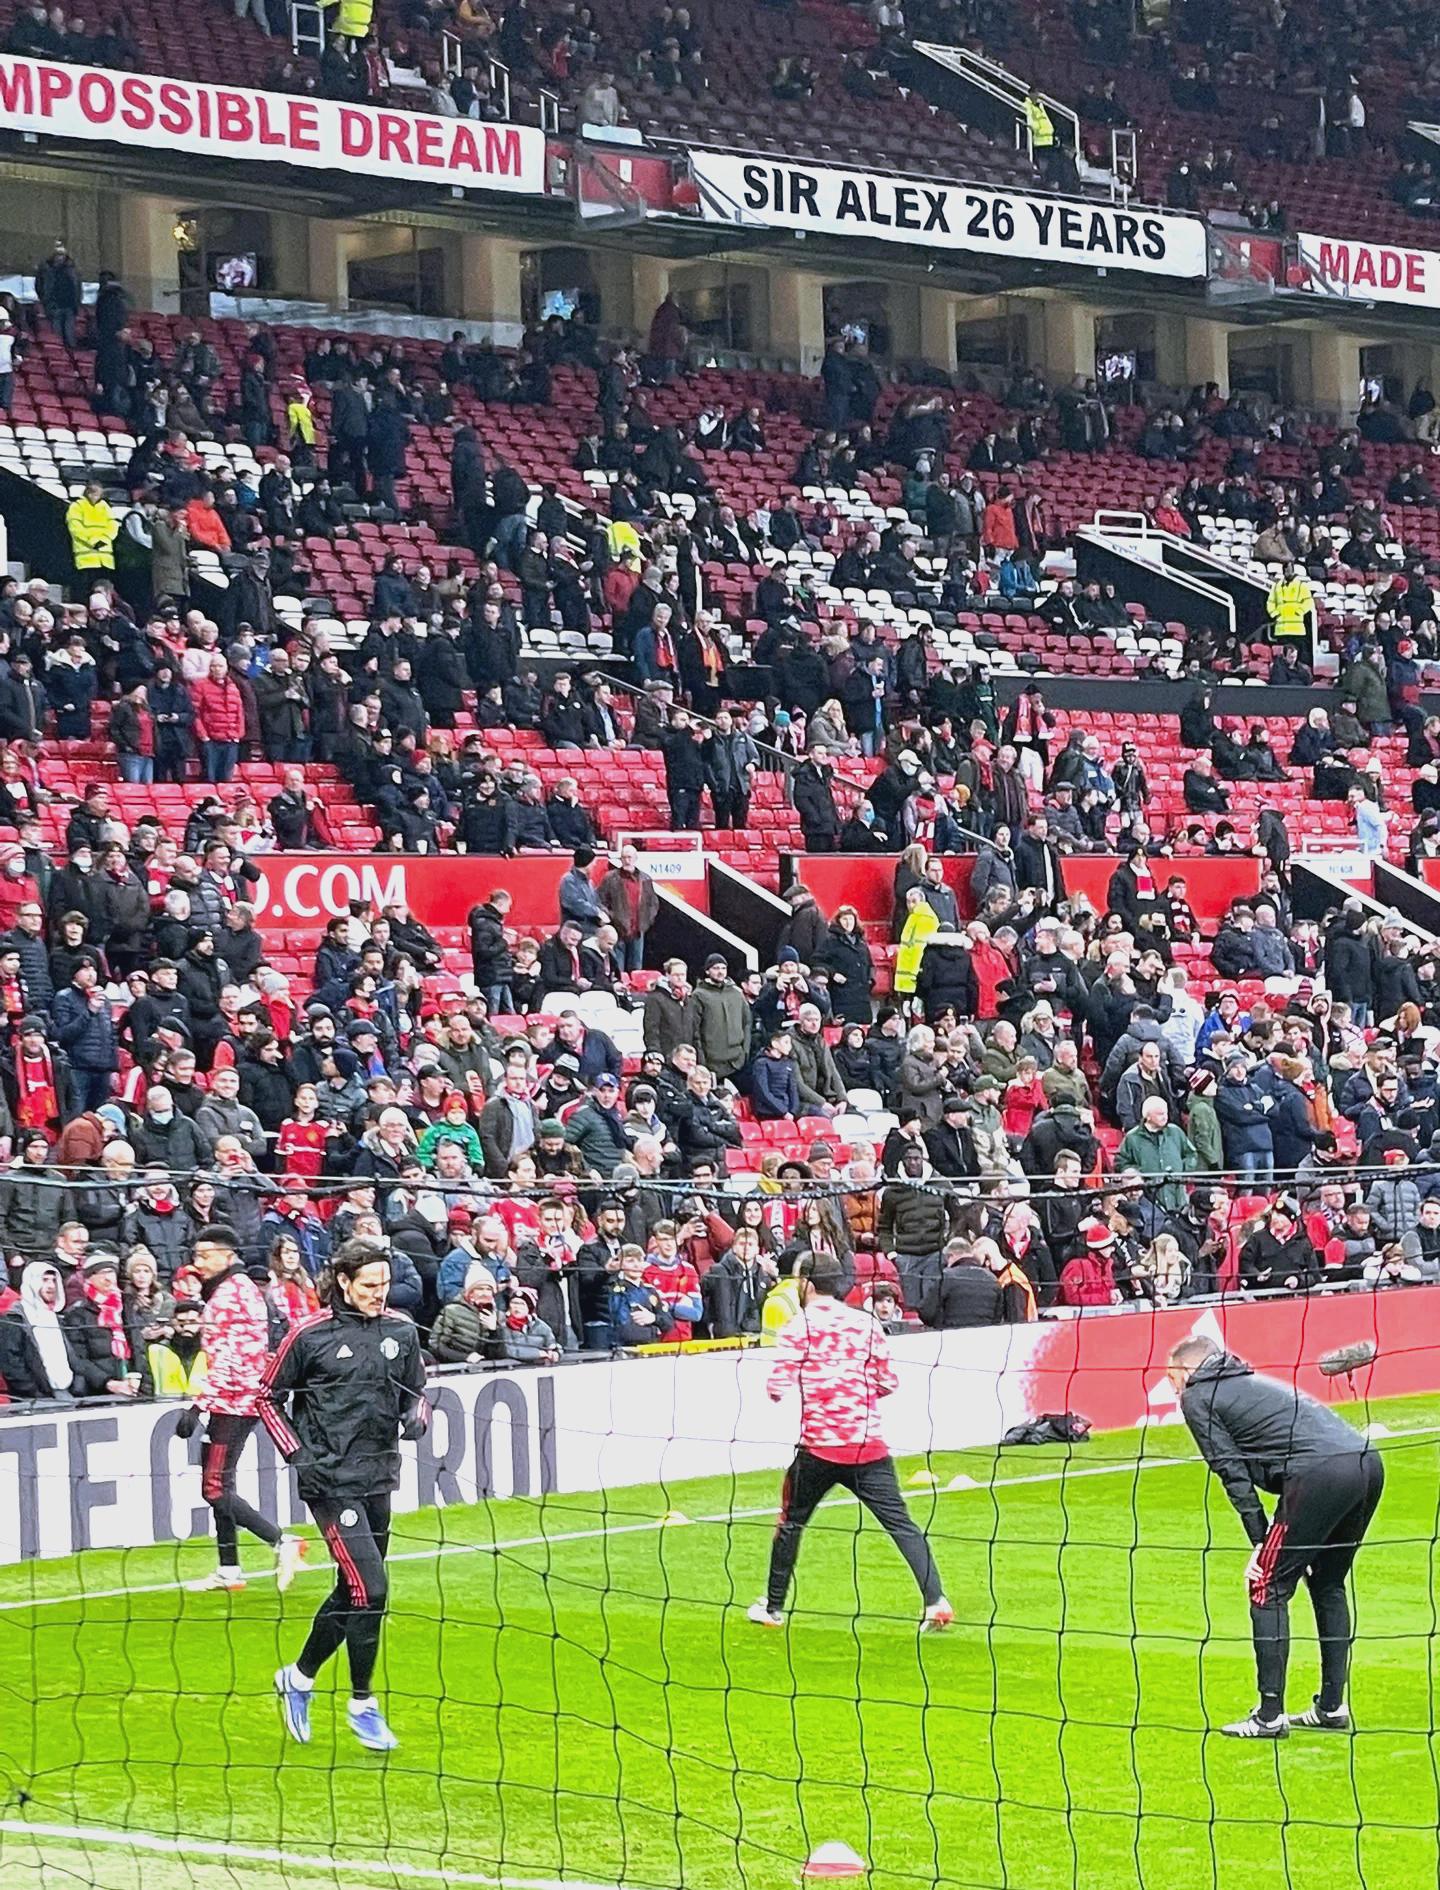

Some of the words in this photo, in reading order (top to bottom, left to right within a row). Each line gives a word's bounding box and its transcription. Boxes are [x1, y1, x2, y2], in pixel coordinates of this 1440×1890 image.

[338, 108, 522, 177] DREAM
[743, 165, 821, 217] SIR
[836, 180, 951, 233] ALEX
[966, 195, 1015, 241] 26
[1026, 202, 1166, 260] YEARS
[1320, 242, 1426, 293] MADE
[650, 863, 682, 873] N1409
